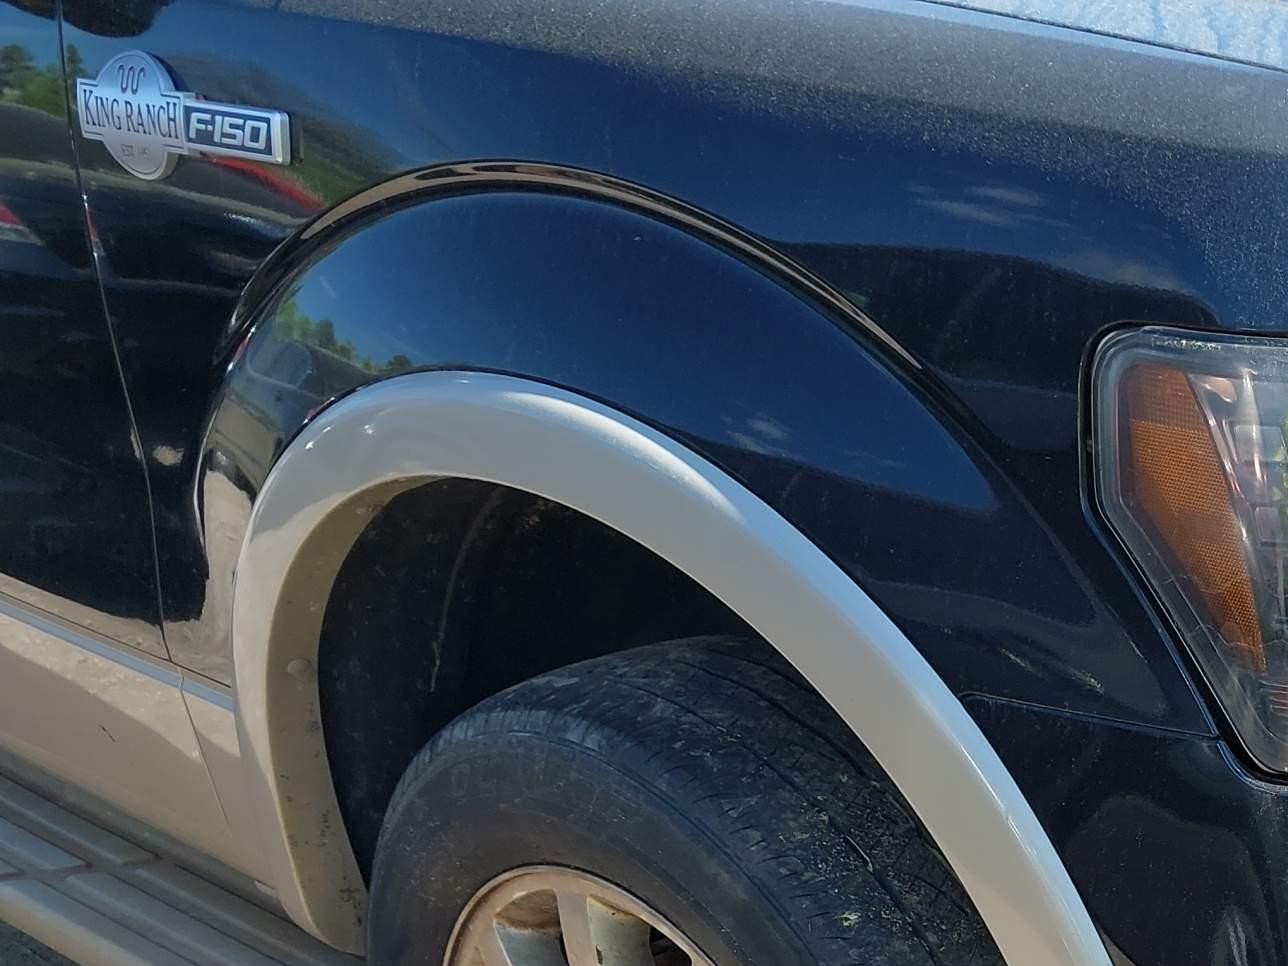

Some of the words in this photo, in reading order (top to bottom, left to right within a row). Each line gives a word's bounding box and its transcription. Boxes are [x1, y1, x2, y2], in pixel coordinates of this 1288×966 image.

[83, 89, 122, 131] KING
[127, 99, 180, 140] RANCH
[189, 112, 268, 150] F-150
